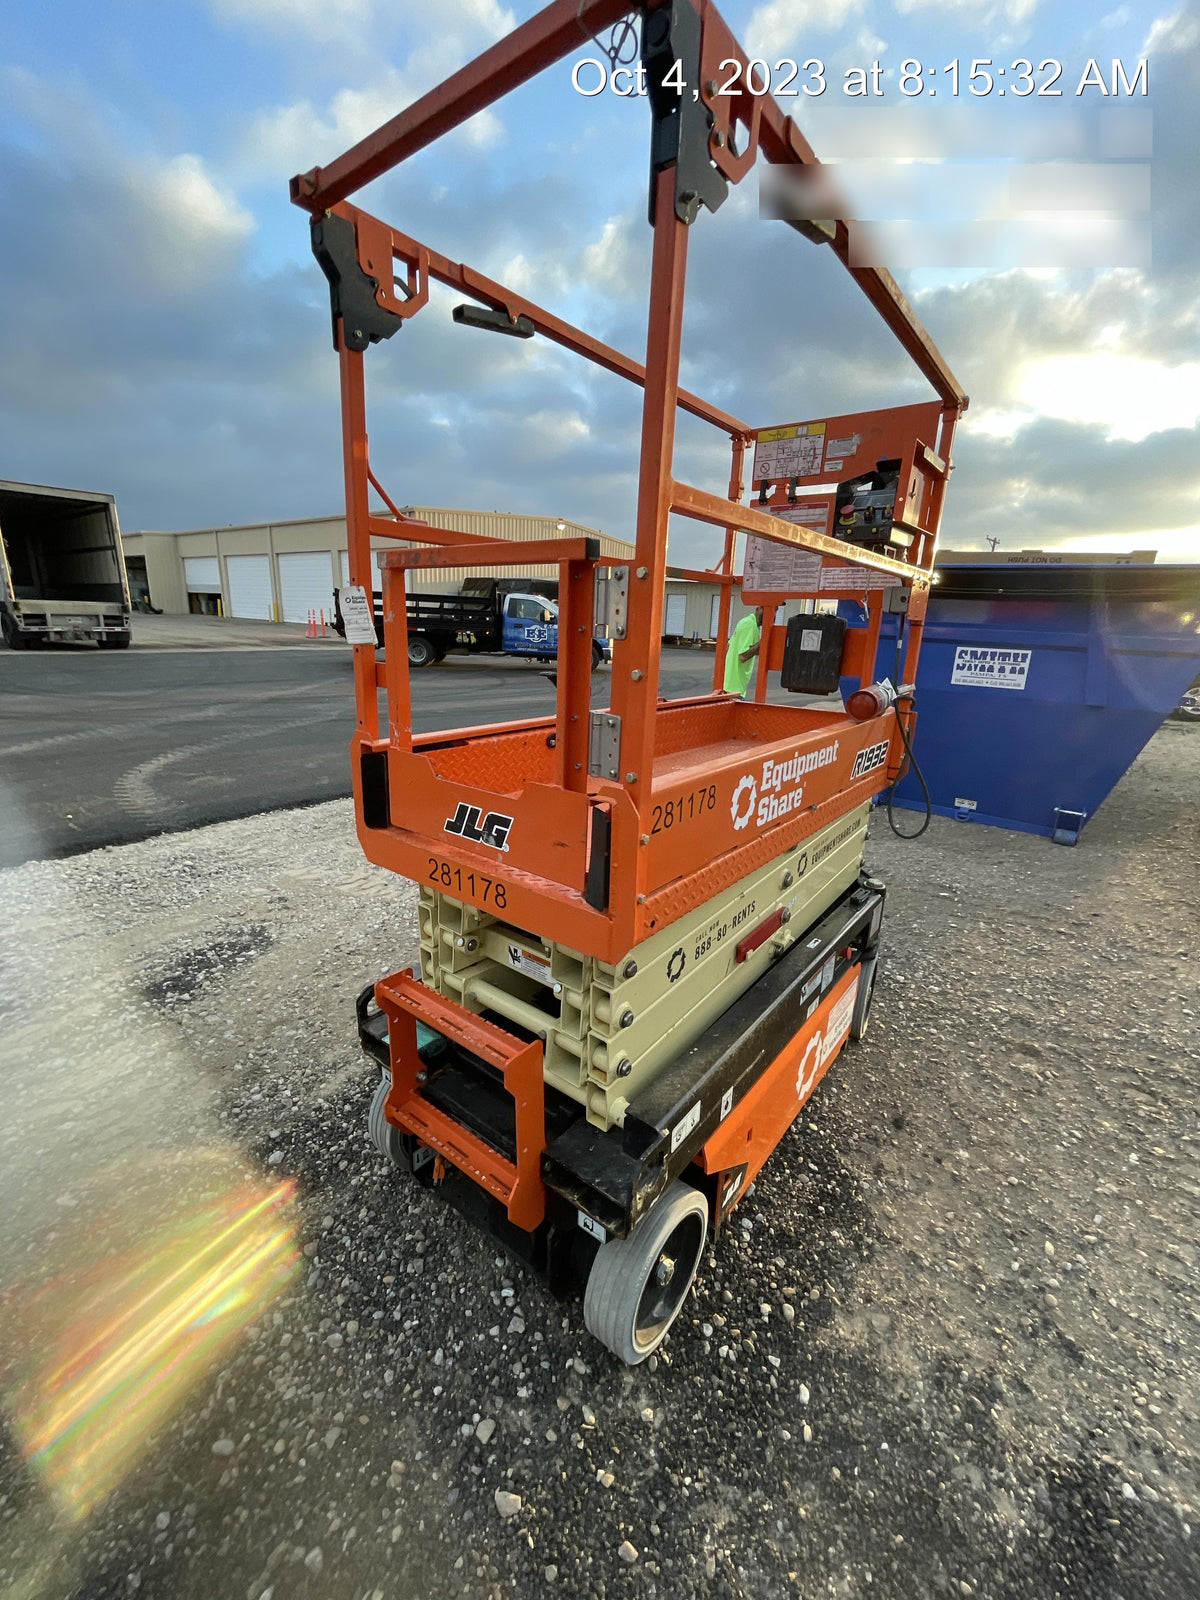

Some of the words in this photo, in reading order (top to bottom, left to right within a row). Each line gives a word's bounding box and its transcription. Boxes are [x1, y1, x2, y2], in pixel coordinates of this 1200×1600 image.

[760, 739, 839, 792] Equipment
[850, 739, 890, 780] R1932
[443, 801, 514, 851] JLG
[650, 784, 717, 835] 281178
[756, 786, 803, 827] Share
[427, 858, 508, 909] 281178
[694, 900, 756, 960] 888-80-RENTS
[695, 931, 708, 943] CALL
